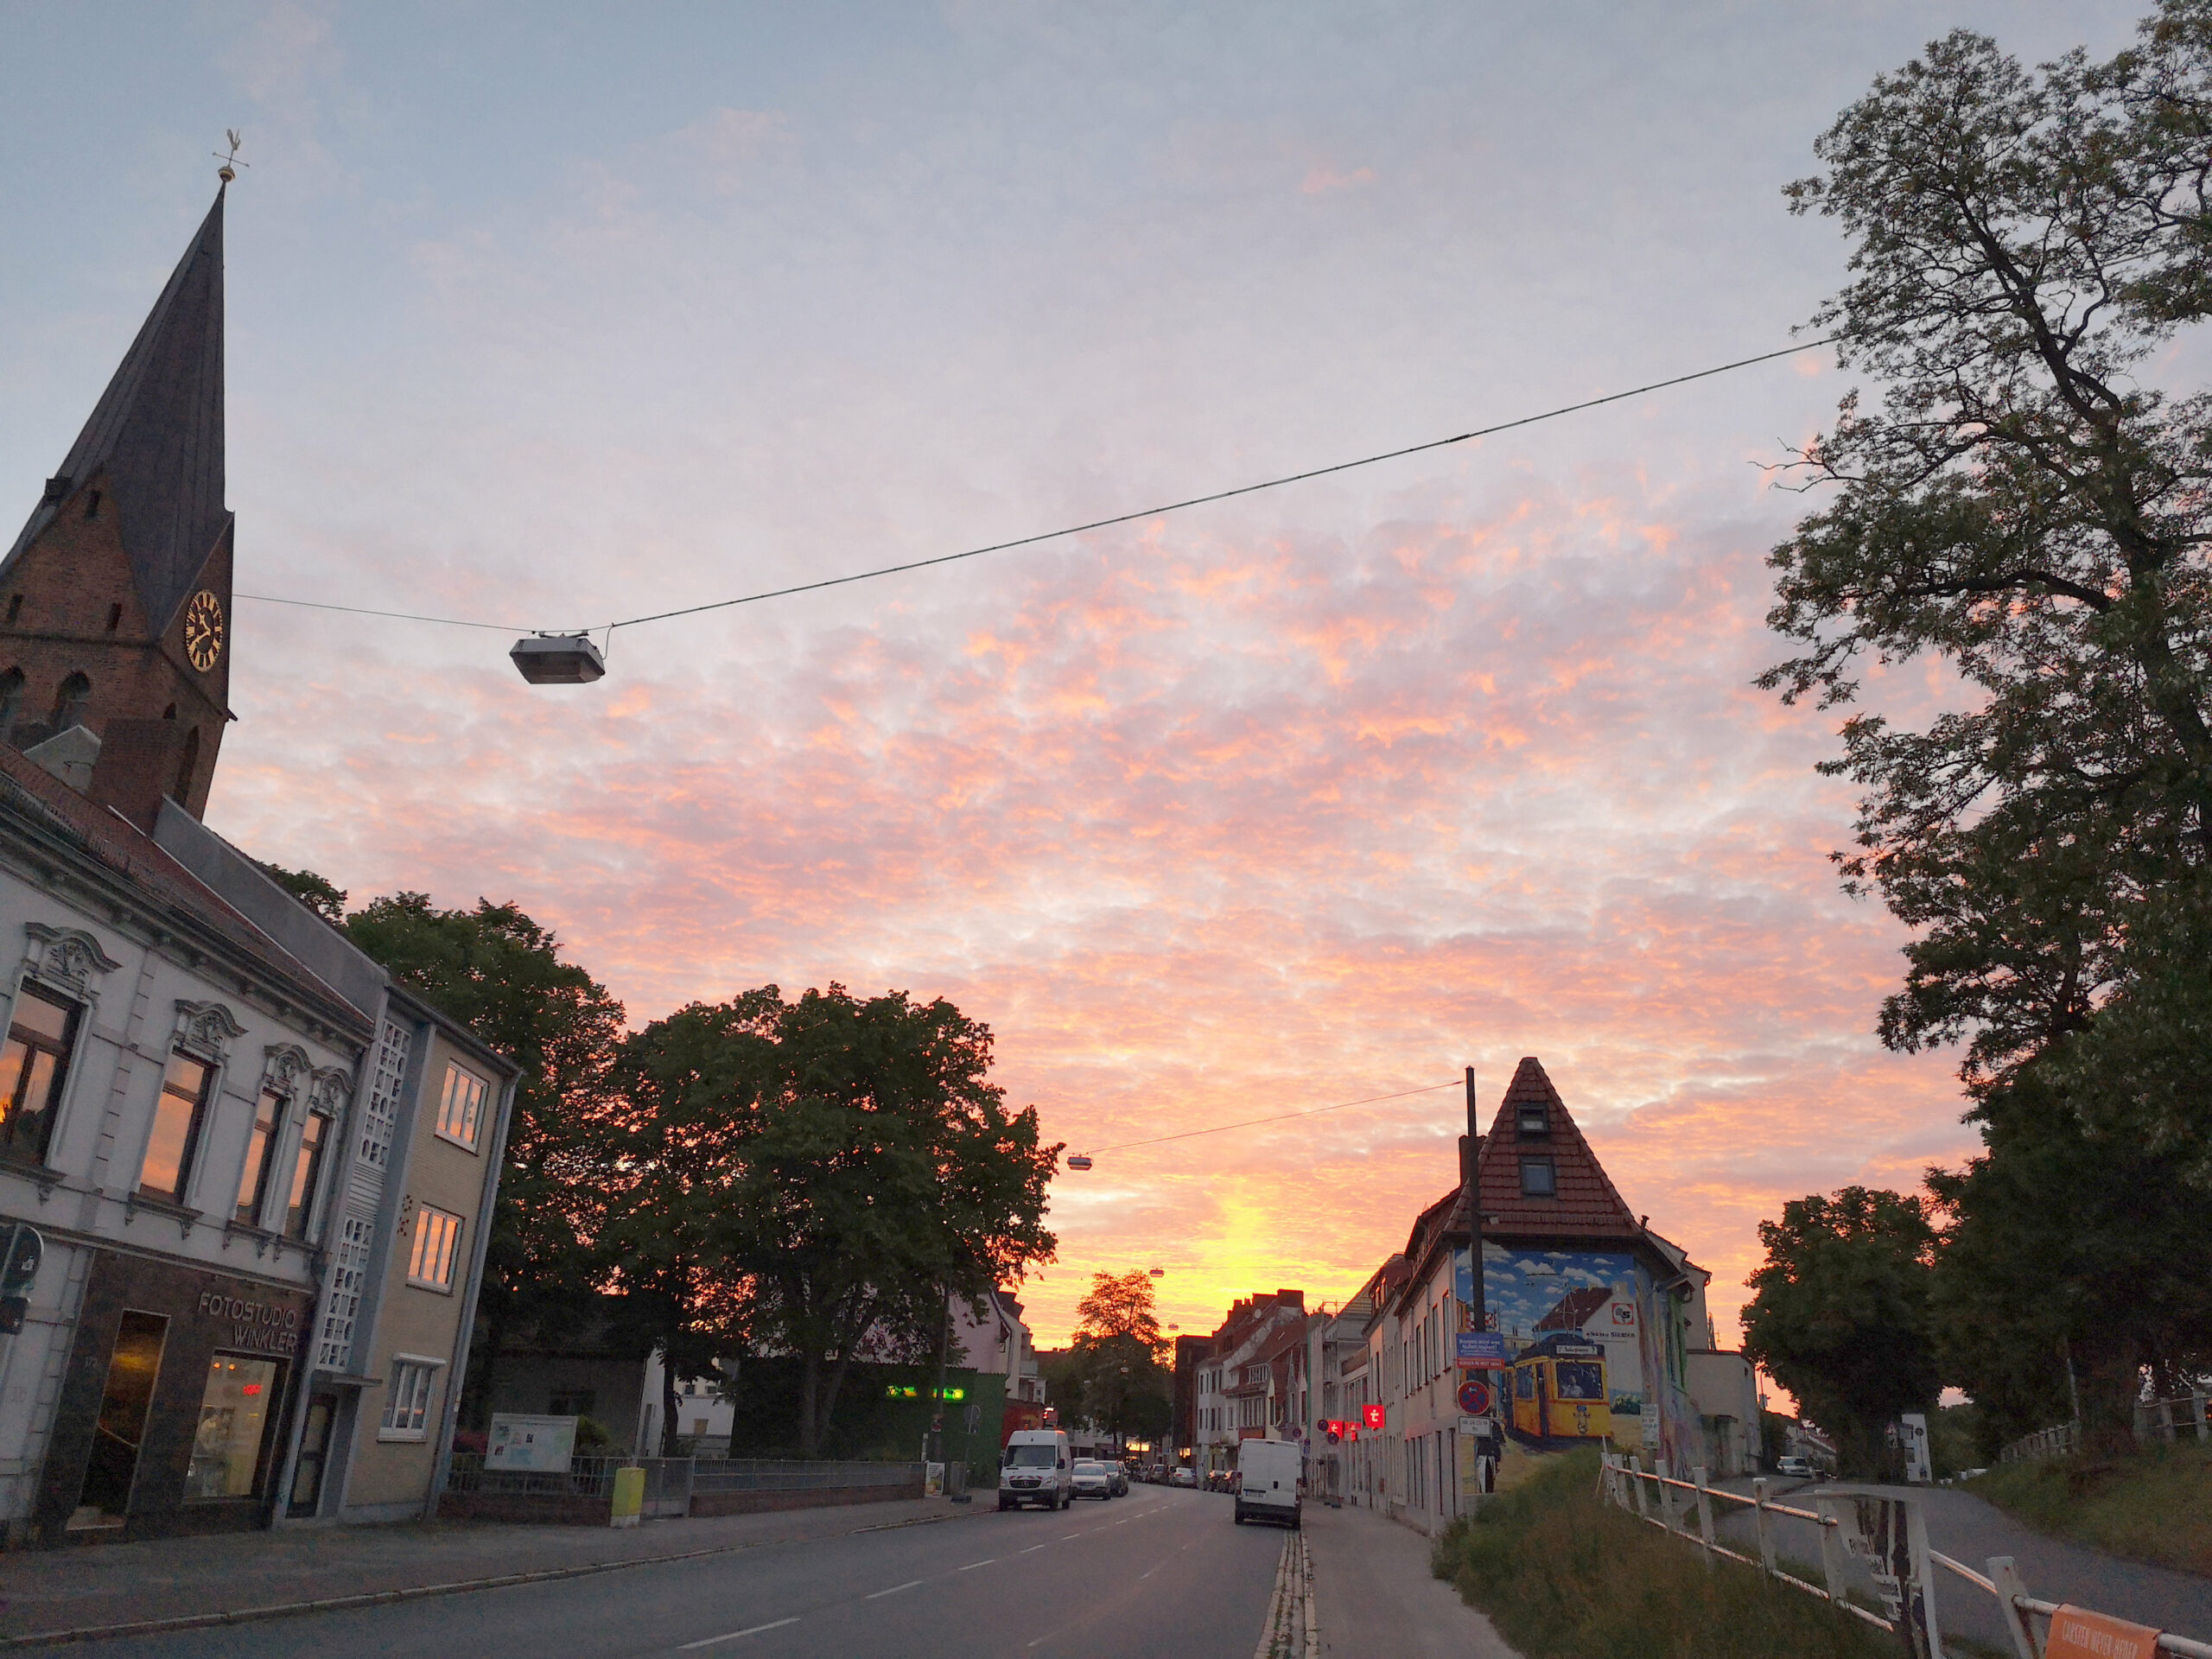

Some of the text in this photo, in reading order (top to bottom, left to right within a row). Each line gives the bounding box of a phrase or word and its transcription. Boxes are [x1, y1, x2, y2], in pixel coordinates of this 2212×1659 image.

[198, 1292, 296, 1329] FOTOSTUDIO
[234, 1325, 298, 1352] WINKLER
[2062, 1619, 2090, 1649] CARSTEN
